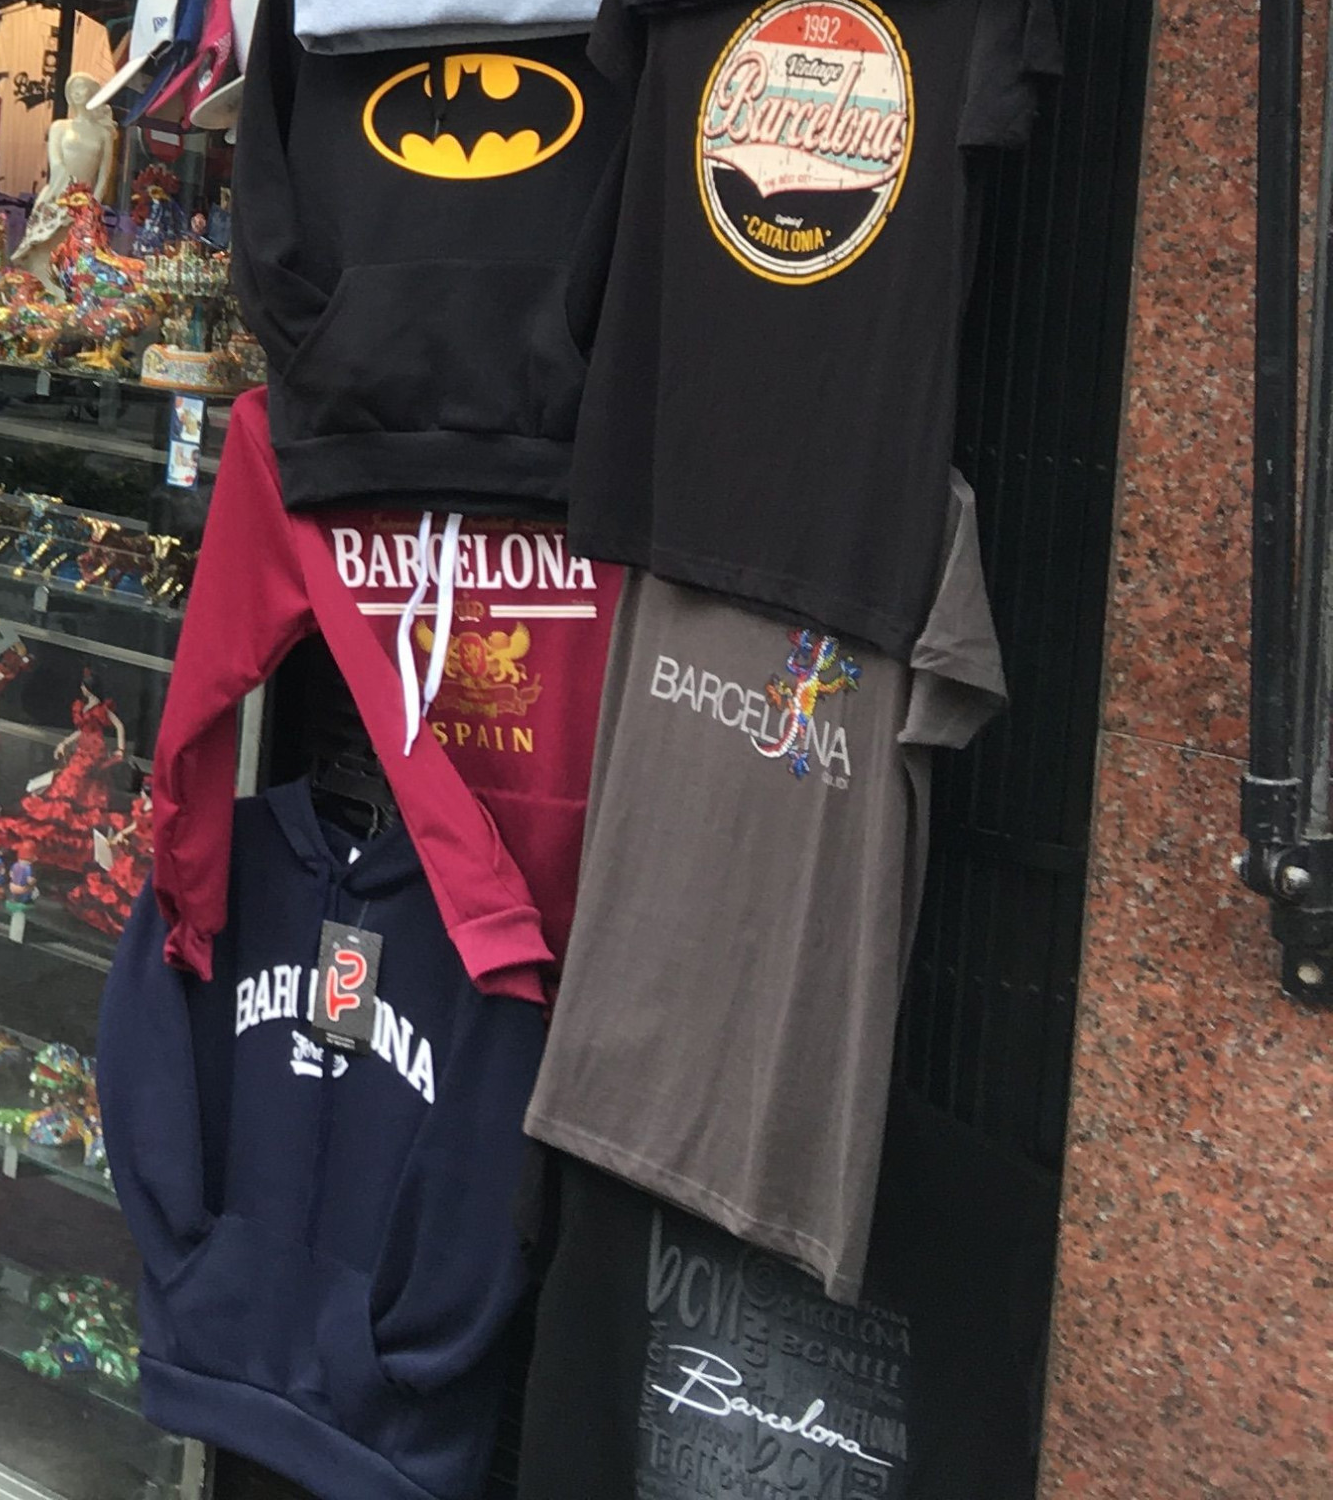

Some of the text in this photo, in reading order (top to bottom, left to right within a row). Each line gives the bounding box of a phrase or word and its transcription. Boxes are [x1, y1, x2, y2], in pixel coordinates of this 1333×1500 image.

[803, 13, 841, 45] 1992
[786, 53, 844, 86] Vintage
[704, 51, 906, 164] Barcelona
[432, 721, 534, 753] SPAIN
[651, 1344, 895, 1468] Barcelona
